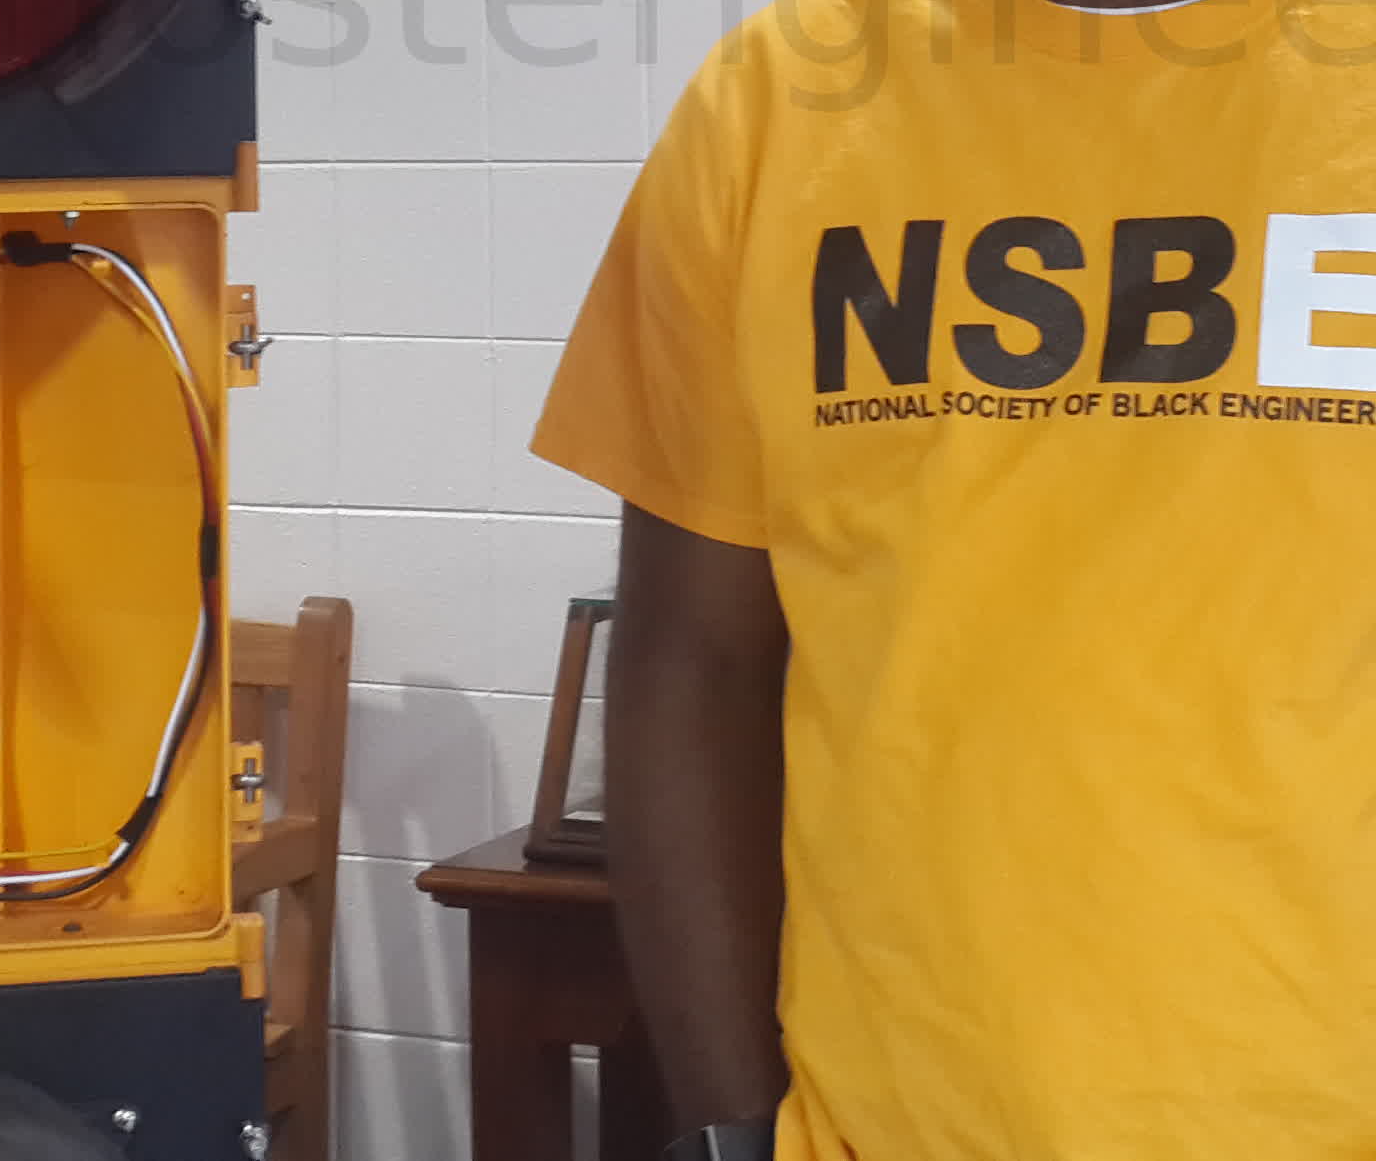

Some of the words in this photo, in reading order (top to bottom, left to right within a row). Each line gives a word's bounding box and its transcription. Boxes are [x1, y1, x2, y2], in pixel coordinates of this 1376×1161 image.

[814, 394, 937, 428] NATIONAL
[942, 390, 1057, 420] SOCIETY
[1063, 391, 1103, 417] OF
[1111, 391, 1209, 418] BLACK
